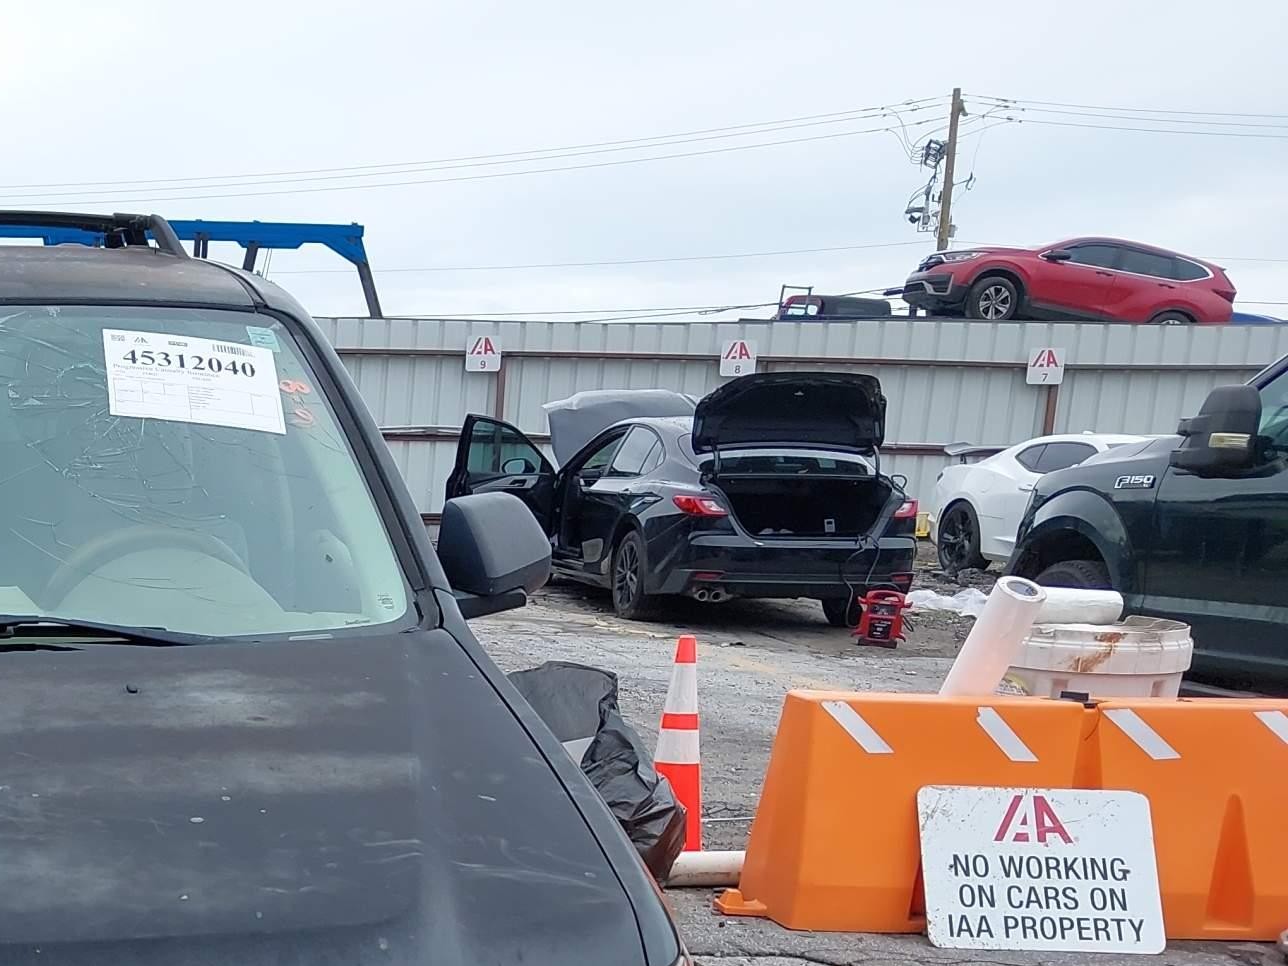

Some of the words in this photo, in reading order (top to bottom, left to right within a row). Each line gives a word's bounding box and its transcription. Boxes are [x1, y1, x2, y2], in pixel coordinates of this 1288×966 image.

[122, 349, 256, 378] 45312040
[480, 360, 487, 369] 9
[734, 365, 741, 374] 8
[1041, 372, 1049, 382] 7
[952, 853, 990, 878] NO
[999, 855, 1130, 882] WORKING
[958, 883, 996, 909] ON
[1006, 885, 1079, 910] CARS
[1089, 887, 1128, 912] ON
[947, 914, 994, 939] IAA
[1003, 915, 1145, 942] PROPERTY
